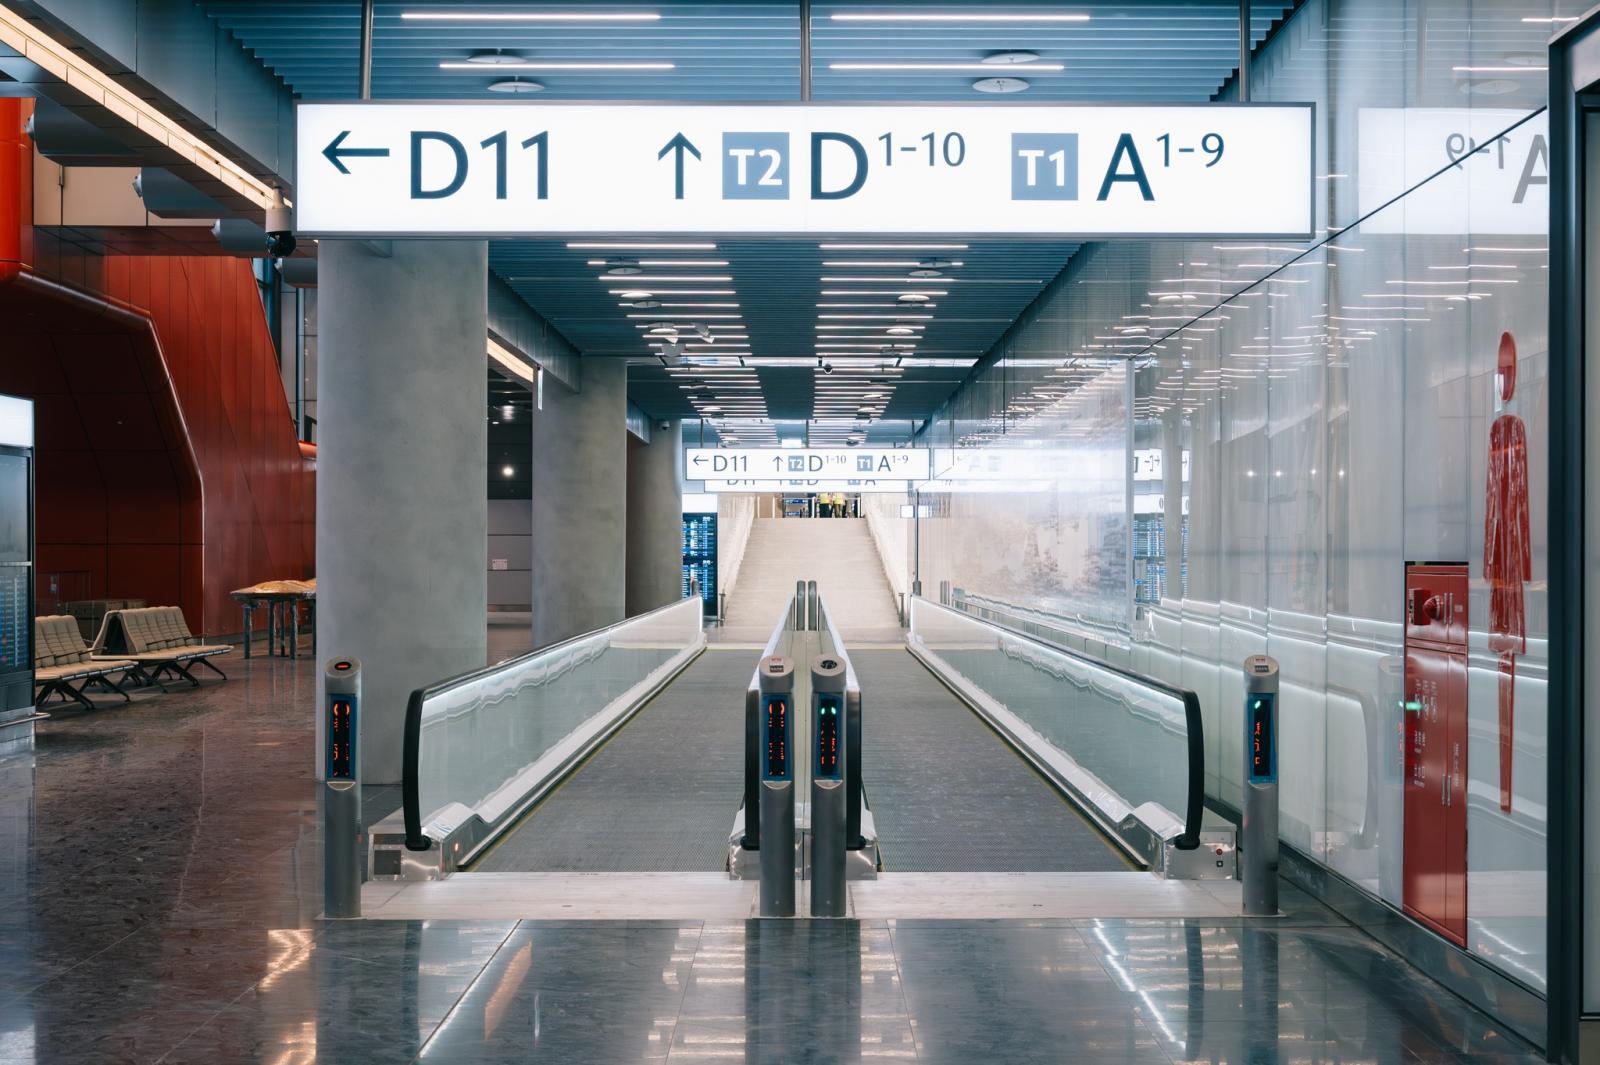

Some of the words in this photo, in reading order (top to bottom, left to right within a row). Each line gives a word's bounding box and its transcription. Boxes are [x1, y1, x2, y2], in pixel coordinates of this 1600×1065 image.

[411, 131, 549, 200] D11
[730, 150, 783, 186] T2
[1019, 151, 1065, 186] T1
[713, 455, 747, 472] D11
[789, 459, 803, 470] T2
[859, 459, 871, 470] T1
